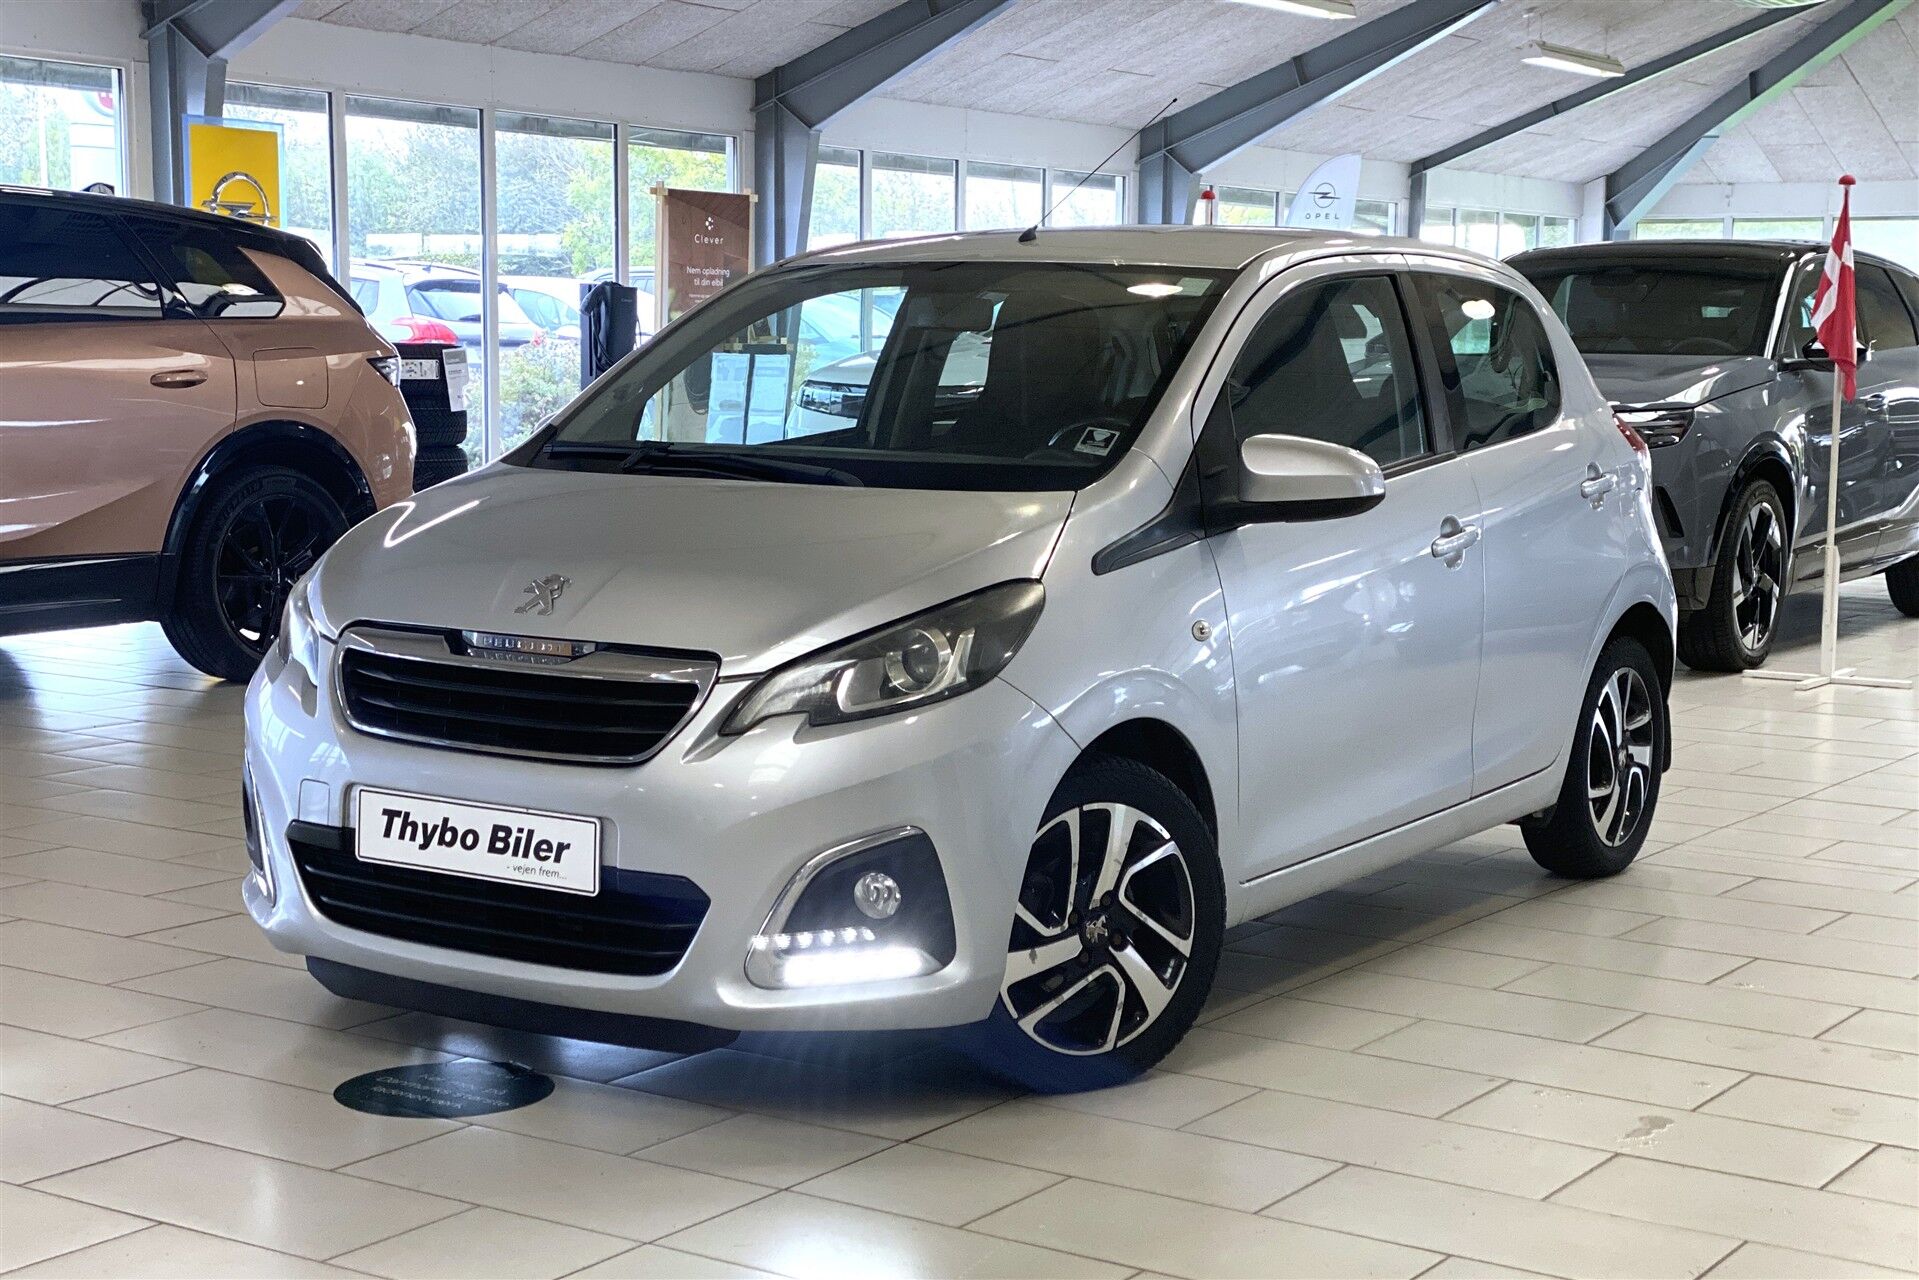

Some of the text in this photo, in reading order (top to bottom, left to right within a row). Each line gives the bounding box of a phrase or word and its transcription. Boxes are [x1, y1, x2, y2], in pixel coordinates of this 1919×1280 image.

[1305, 212, 1339, 220] OPEL
[694, 234, 723, 245] Clever
[686, 266, 701, 275] Nem
[381, 808, 571, 864] Thybo Biler
[513, 864, 536, 876] vejen
